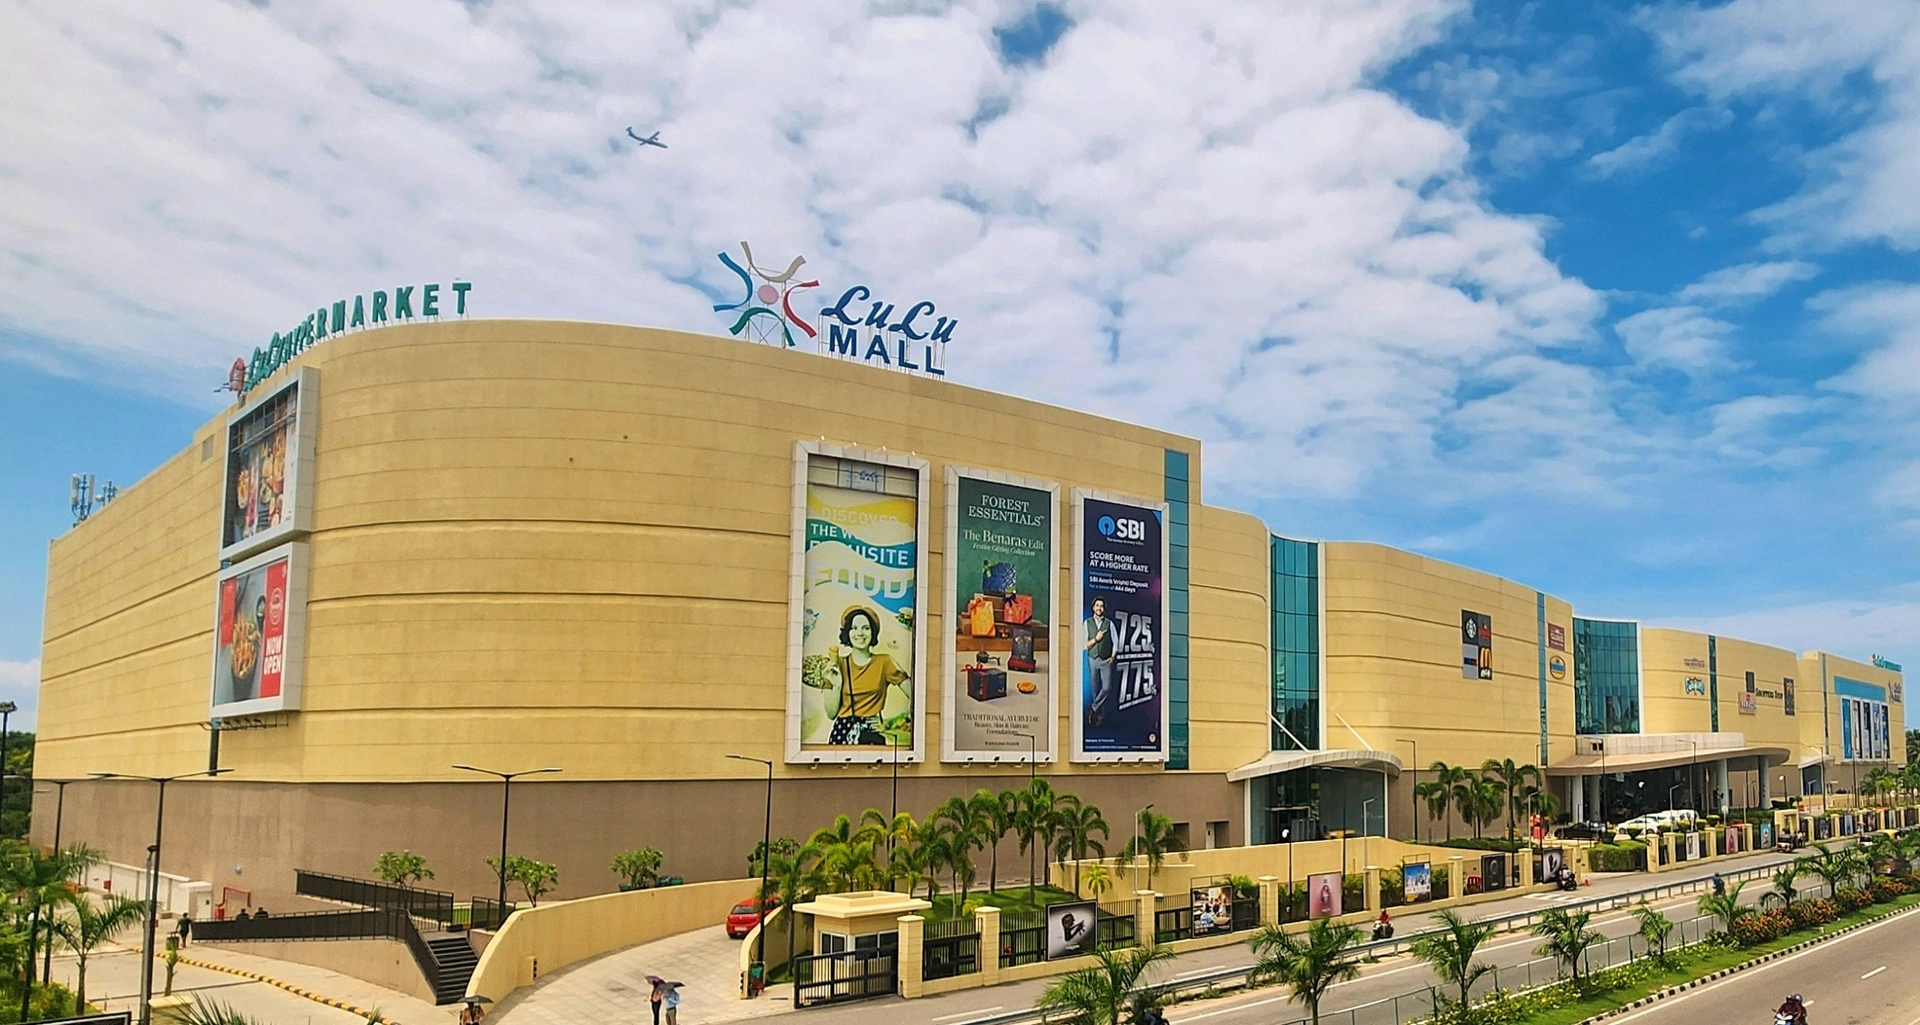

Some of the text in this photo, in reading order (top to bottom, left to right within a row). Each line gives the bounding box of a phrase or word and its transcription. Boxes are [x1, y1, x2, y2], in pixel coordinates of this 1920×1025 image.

[280, 282, 472, 363] HYPERMARKET
[820, 285, 958, 343] LuLu
[829, 323, 945, 376] MALL
[981, 494, 1030, 513] FOREST
[810, 523, 837, 538] THE
[962, 529, 1045, 550] The Benaras Edit
[1116, 518, 1145, 541] SBI
[1089, 551, 1134, 563] SCORE MORE
[1089, 559, 1099, 567] AT
[1106, 561, 1132, 571] HIGHER
[1132, 564, 1149, 573] RATE
[808, 561, 908, 600] FOOD
[266, 635, 283, 656] NOW
[263, 653, 282, 676] OPEN
[963, 713, 1005, 721] TRADITIONAL
